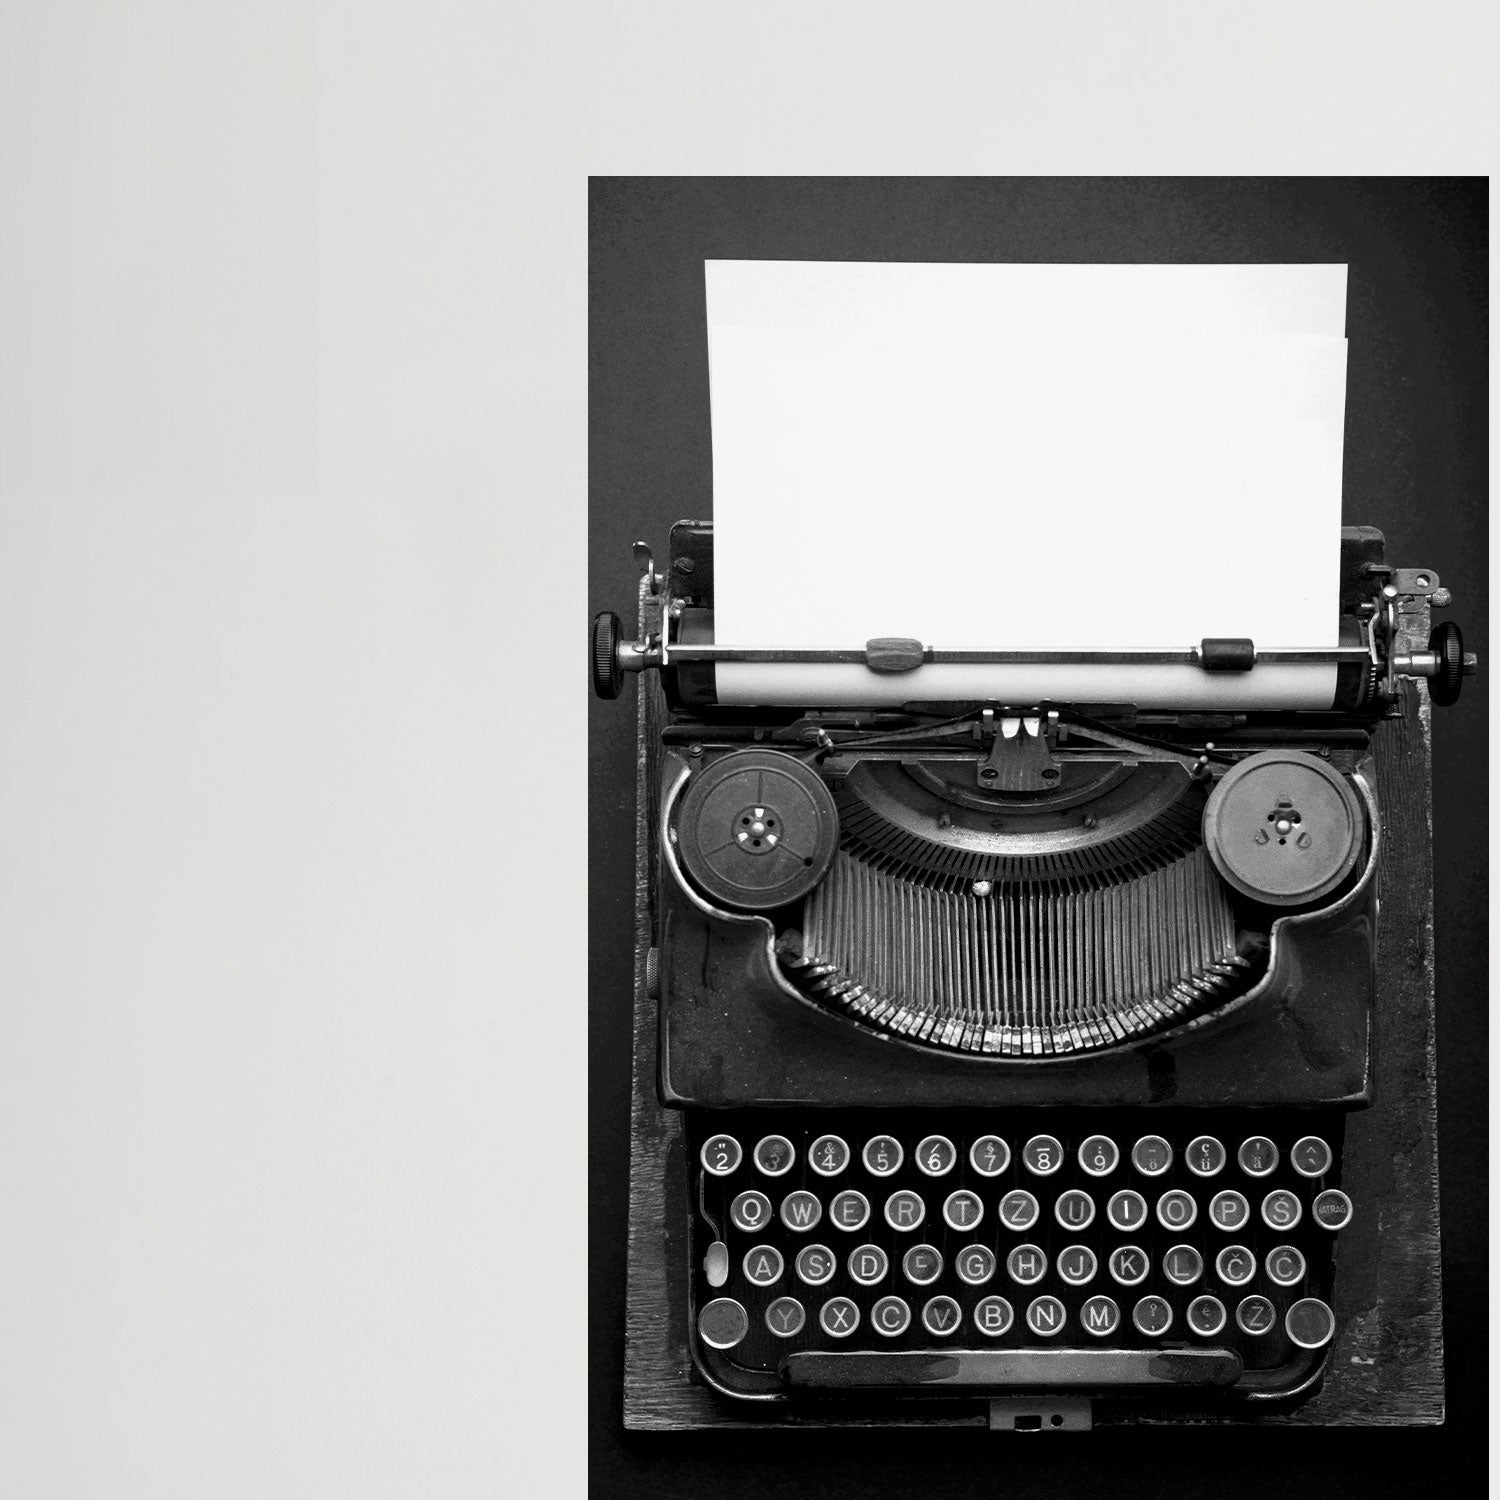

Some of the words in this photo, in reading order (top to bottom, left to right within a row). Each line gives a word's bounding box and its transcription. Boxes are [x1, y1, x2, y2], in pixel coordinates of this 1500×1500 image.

[716, 1153, 729, 1170] 2
[821, 1153, 836, 1170] 4
[876, 1154, 889, 1171] 5
[928, 1153, 941, 1170] 6
[984, 1155, 996, 1171] 7
[1037, 1153, 1051, 1170] 8
[1094, 1155, 1106, 1171] 9
[742, 1199, 761, 1225] Q
[792, 1202, 812, 1224] W
[843, 1201, 859, 1223] E
[898, 1201, 914, 1223] R
[955, 1201, 971, 1222] T
[1010, 1201, 1027, 1223] Z
[1068, 1201, 1084, 1222] U
[1124, 1200, 1129, 1219] I
[1166, 1199, 1186, 1222] O
[1221, 1201, 1237, 1223] P
[755, 1255, 772, 1278] A
[809, 1255, 823, 1277] S
[861, 1255, 877, 1277] D
[966, 1254, 985, 1277] G
[1018, 1255, 1035, 1277] H
[1069, 1255, 1084, 1277] J
[1121, 1255, 1137, 1276] K
[1174, 1255, 1189, 1277] L
[776, 1308, 794, 1330] Y
[833, 1307, 848, 1328] X
[882, 1306, 900, 1329] C
[934, 1308, 951, 1329] V
[986, 1305, 1002, 1327] B
[1036, 1305, 1054, 1326] N
[1089, 1305, 1108, 1327] M
